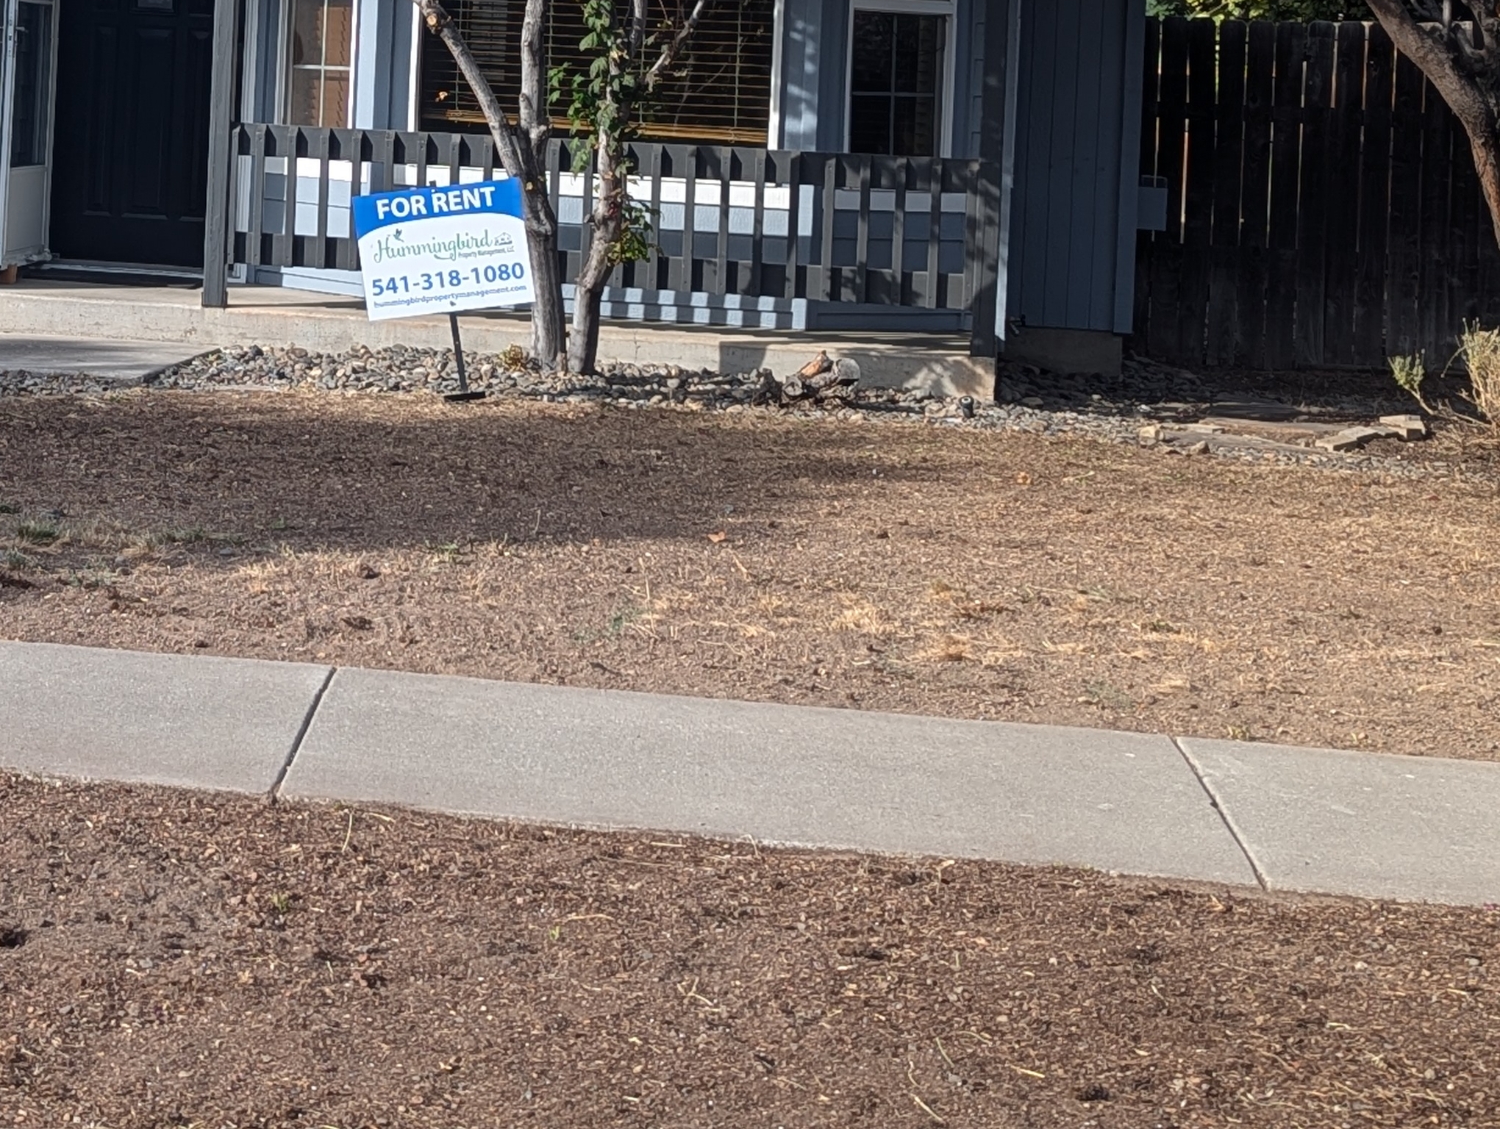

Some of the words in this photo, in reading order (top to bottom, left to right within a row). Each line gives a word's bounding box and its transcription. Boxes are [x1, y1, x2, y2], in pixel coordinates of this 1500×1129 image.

[376, 195, 428, 220] FOR
[431, 186, 496, 214] RENT
[373, 229, 493, 263] Hummingbird
[372, 262, 525, 296] 541-318-1080
[373, 284, 527, 308] hummingbirdpropertymanagement.com
